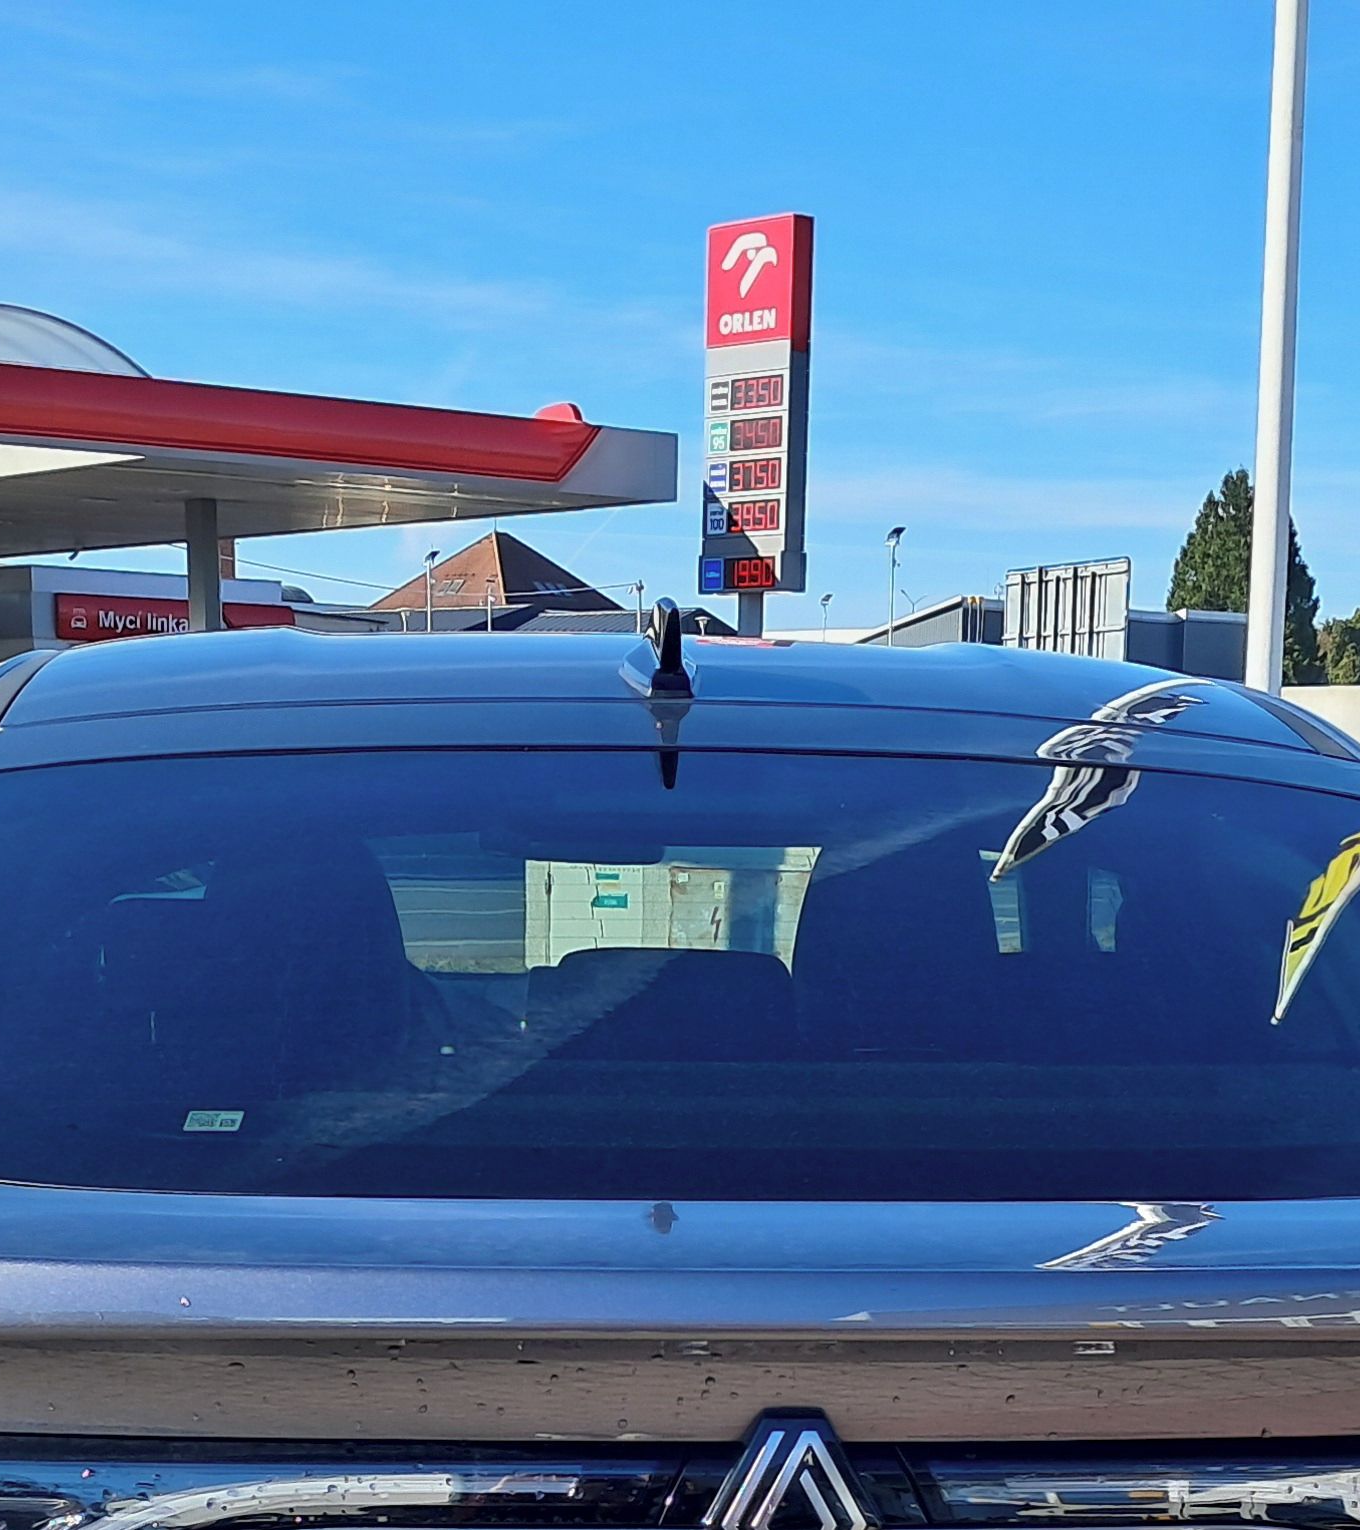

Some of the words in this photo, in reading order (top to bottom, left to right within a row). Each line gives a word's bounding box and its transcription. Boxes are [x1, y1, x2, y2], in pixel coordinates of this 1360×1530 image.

[719, 307, 777, 335] ORLEN
[712, 436, 725, 450] 95
[710, 518, 724, 530] 100
[99, 610, 140, 633] Mycí
[147, 612, 188, 632] linka
